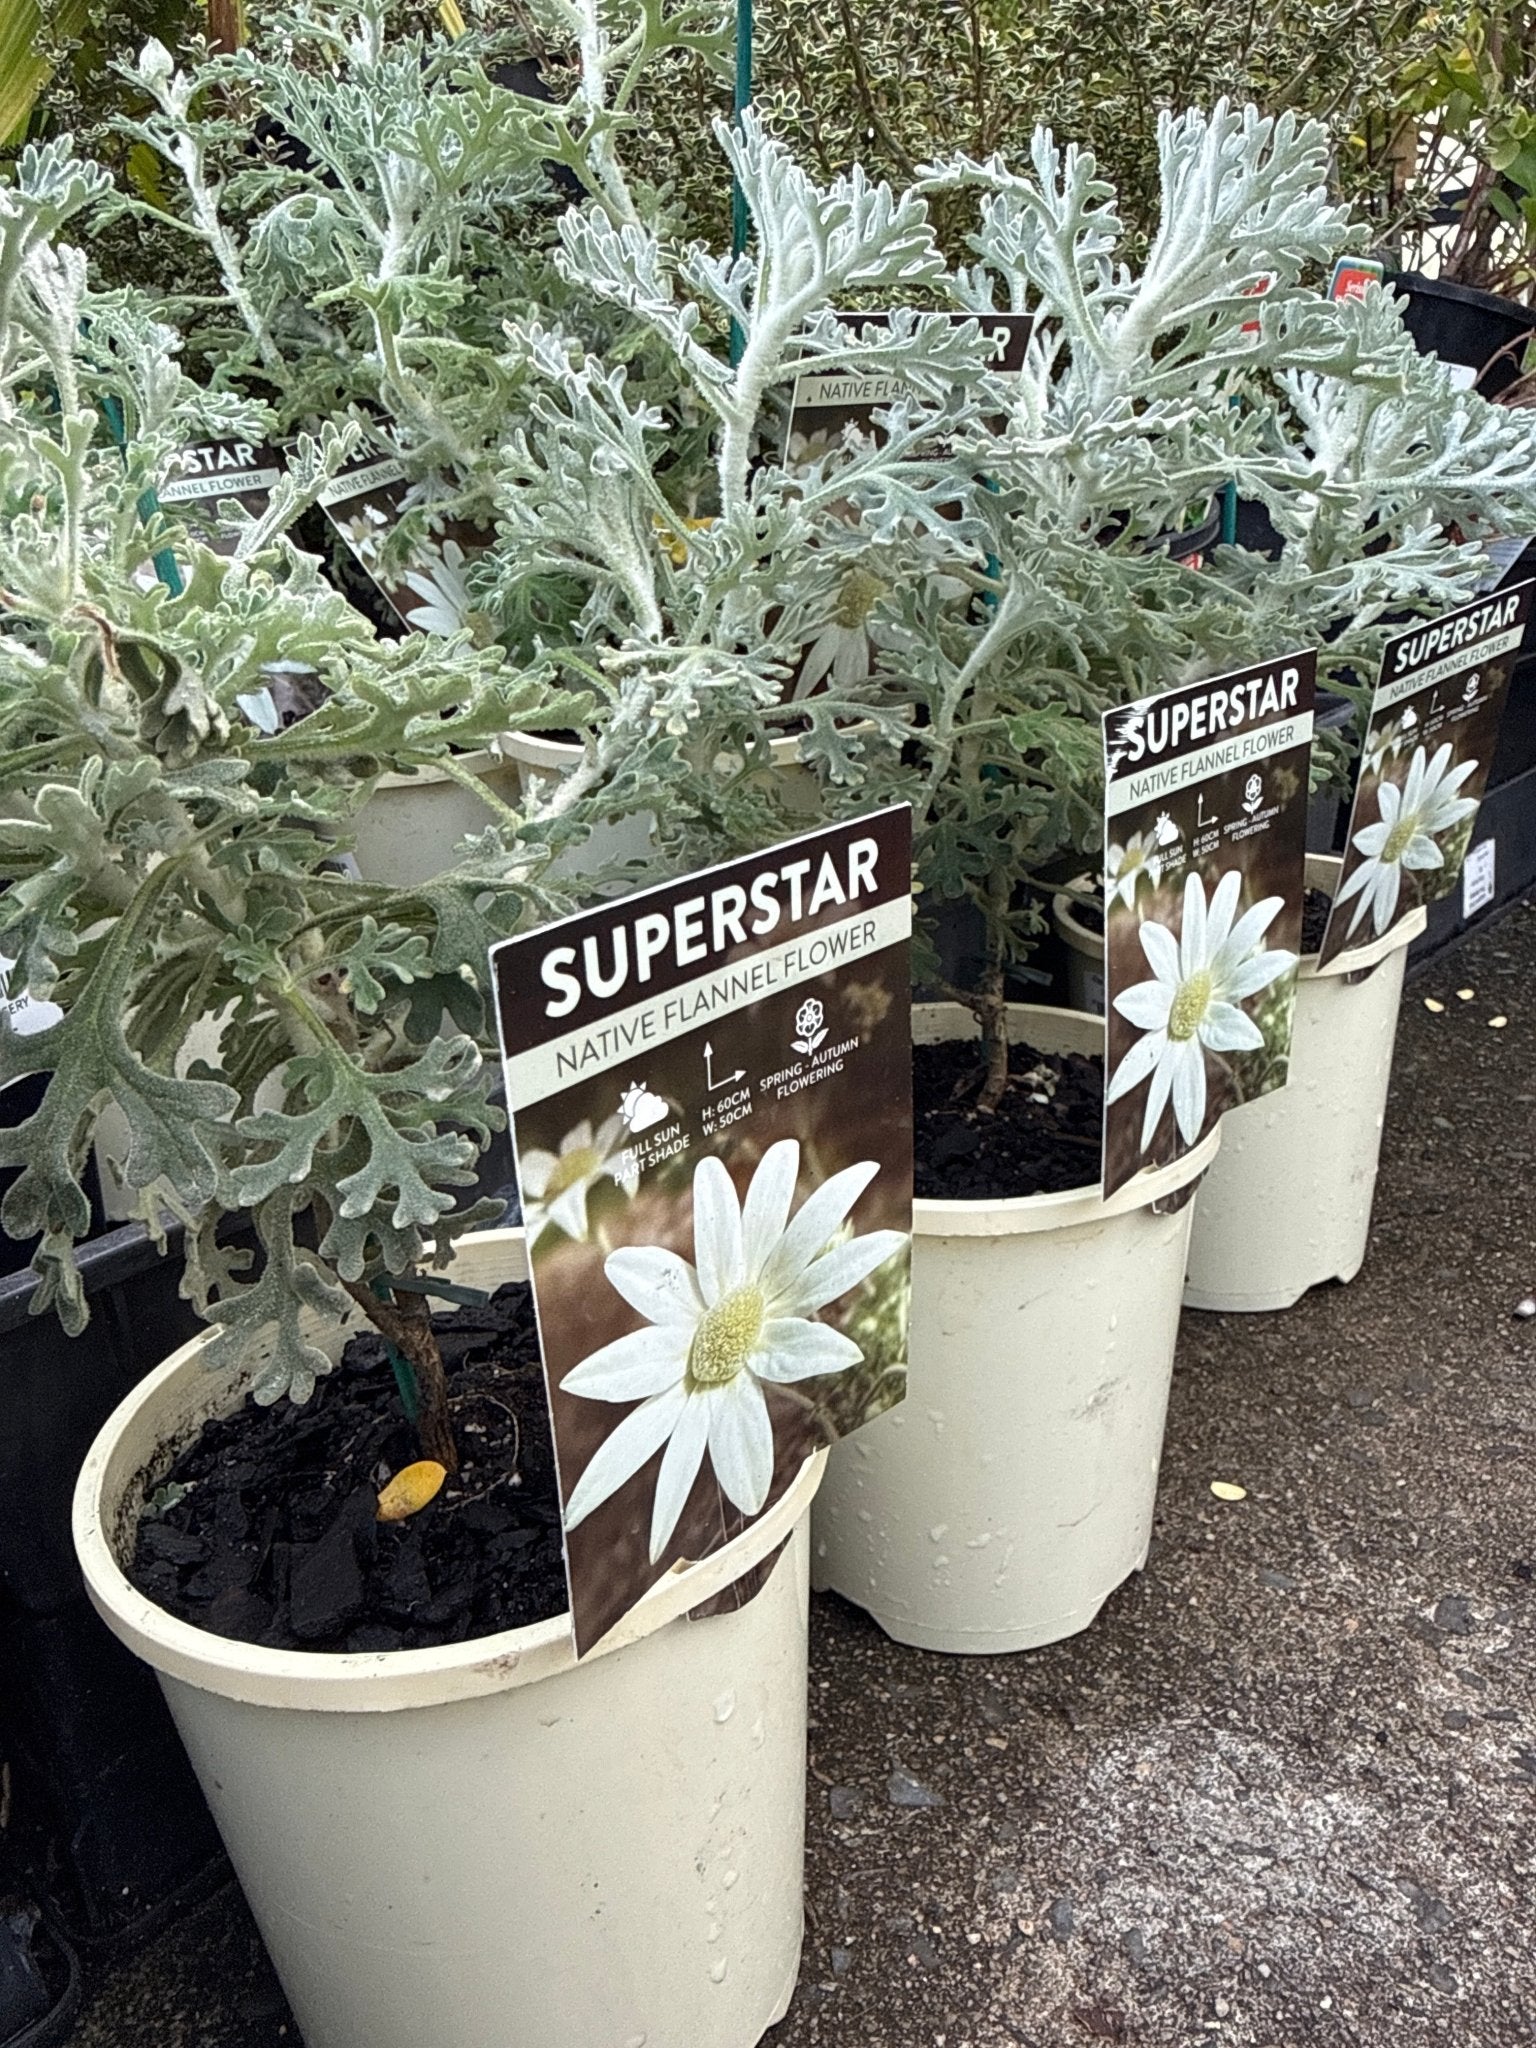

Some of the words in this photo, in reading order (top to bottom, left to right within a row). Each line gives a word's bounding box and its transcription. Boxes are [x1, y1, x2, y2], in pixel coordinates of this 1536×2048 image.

[819, 381, 871, 400] NATIVE
[209, 475, 262, 492] FLOWER
[328, 476, 361, 497] NATIVE
[1393, 595, 1520, 673] SUPERSTAR
[1389, 672, 1425, 700] NATIVE
[1426, 654, 1469, 686] FLANNEL
[1469, 636, 1510, 665] FLOWER
[1125, 668, 1299, 762] SUPERSTAR
[1130, 769, 1178, 801] NATIVE
[1181, 747, 1240, 778] FLANNEL
[1242, 725, 1295, 759] FLOWER
[540, 837, 880, 1018] SUPERSTAR
[556, 1011, 656, 1079] NATIVE
[664, 964, 779, 1031] FLANNEL
[784, 920, 877, 979] FLOWER
[759, 1063, 803, 1092] SPRING
[811, 1036, 859, 1068] AUTUMN
[777, 1059, 844, 1100] FLOWERING
[702, 1106, 716, 1122] H:
[717, 1087, 751, 1113] 60CM
[702, 1122, 718, 1137] W:
[719, 1102, 753, 1129] 50CM
[613, 1161, 646, 1188] PART
[648, 1134, 691, 1167] SHADE
[621, 1139, 653, 1166] FULL
[654, 1123, 681, 1148] SUN
